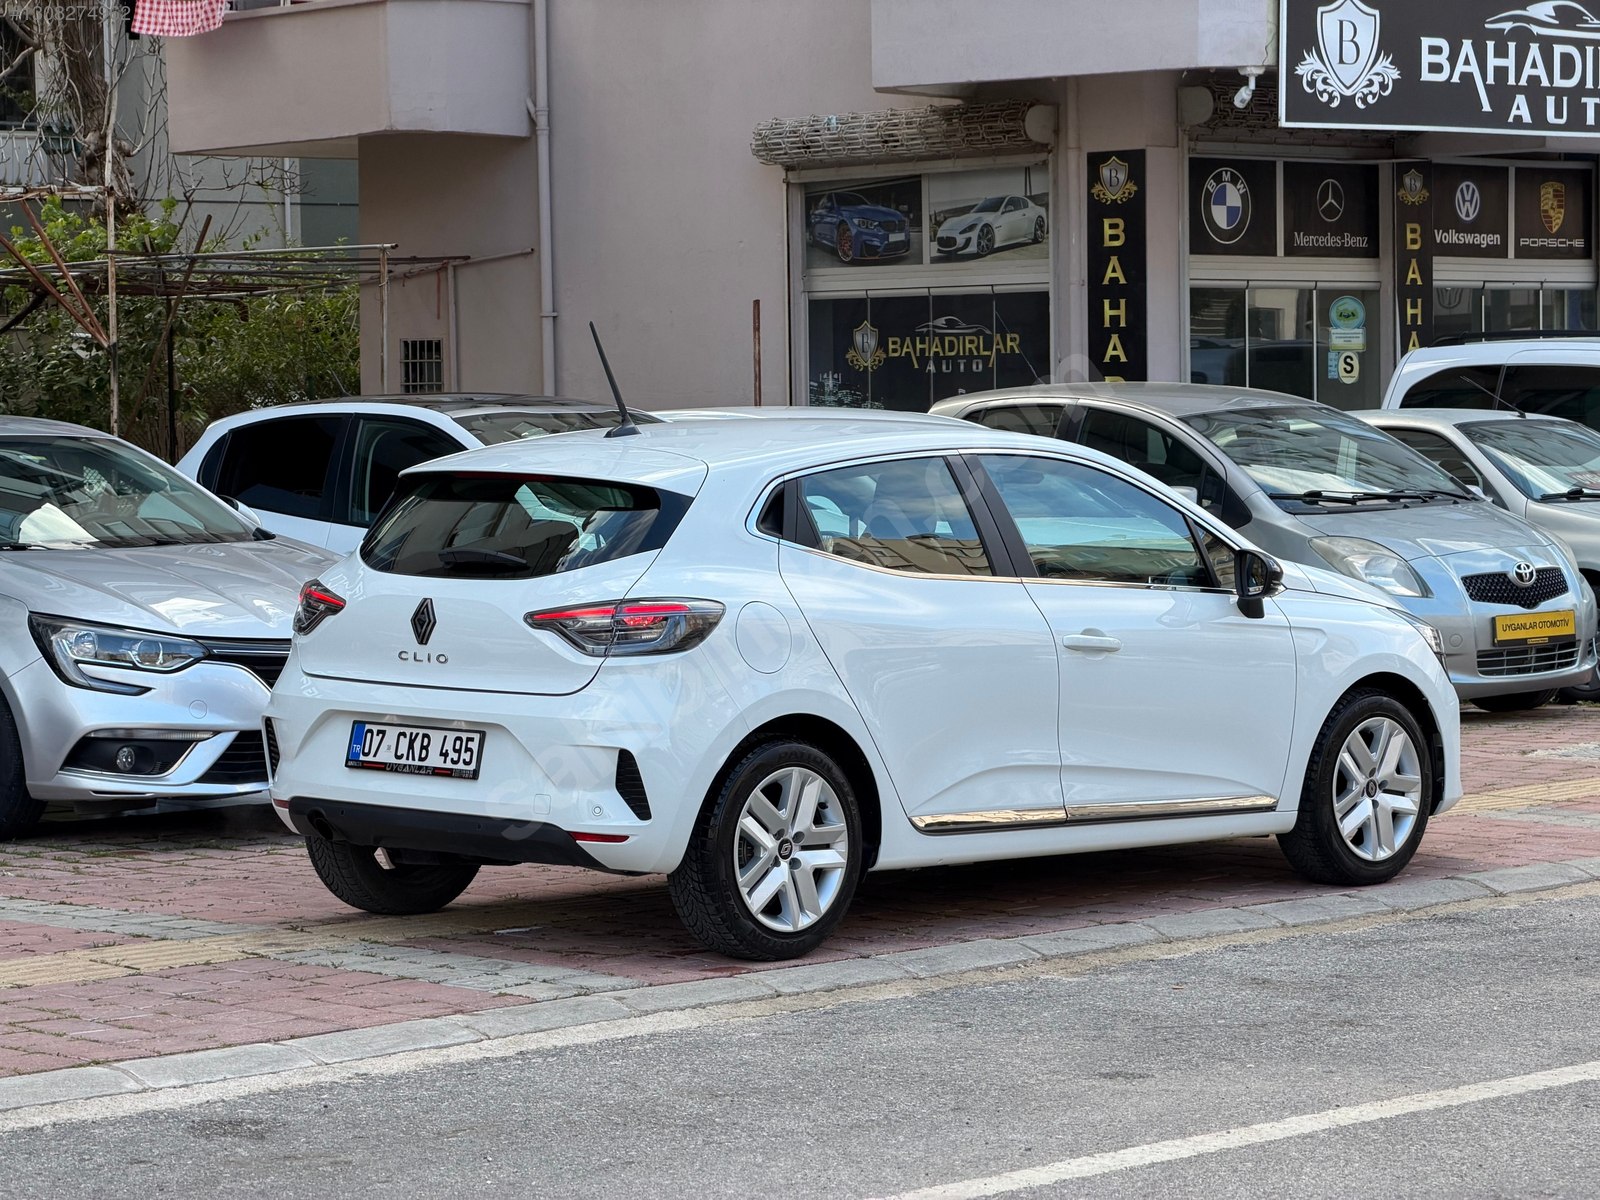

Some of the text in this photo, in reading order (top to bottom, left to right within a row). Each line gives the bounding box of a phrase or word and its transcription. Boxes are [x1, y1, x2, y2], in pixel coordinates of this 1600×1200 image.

[1337, 19, 1361, 65] B
[1420, 36, 1600, 112] BAHADI
[1507, 94, 1600, 125] AUT
[1206, 171, 1246, 195] BMW
[1293, 231, 1368, 248] Mercedes-Benz
[1434, 229, 1501, 248] Volkswagen
[1520, 238, 1585, 248] PORSCHE
[1102, 217, 1129, 383] BAHA
[887, 333, 1021, 368] BAHADIRLAR
[925, 359, 983, 373] AUTO
[1343, 355, 1354, 374] S
[1501, 618, 1570, 632] UYGANLAR OTOMOTİV
[398, 650, 449, 664] CLIO
[352, 744, 361, 753] TR
[362, 728, 475, 766] 07 CKB 495
